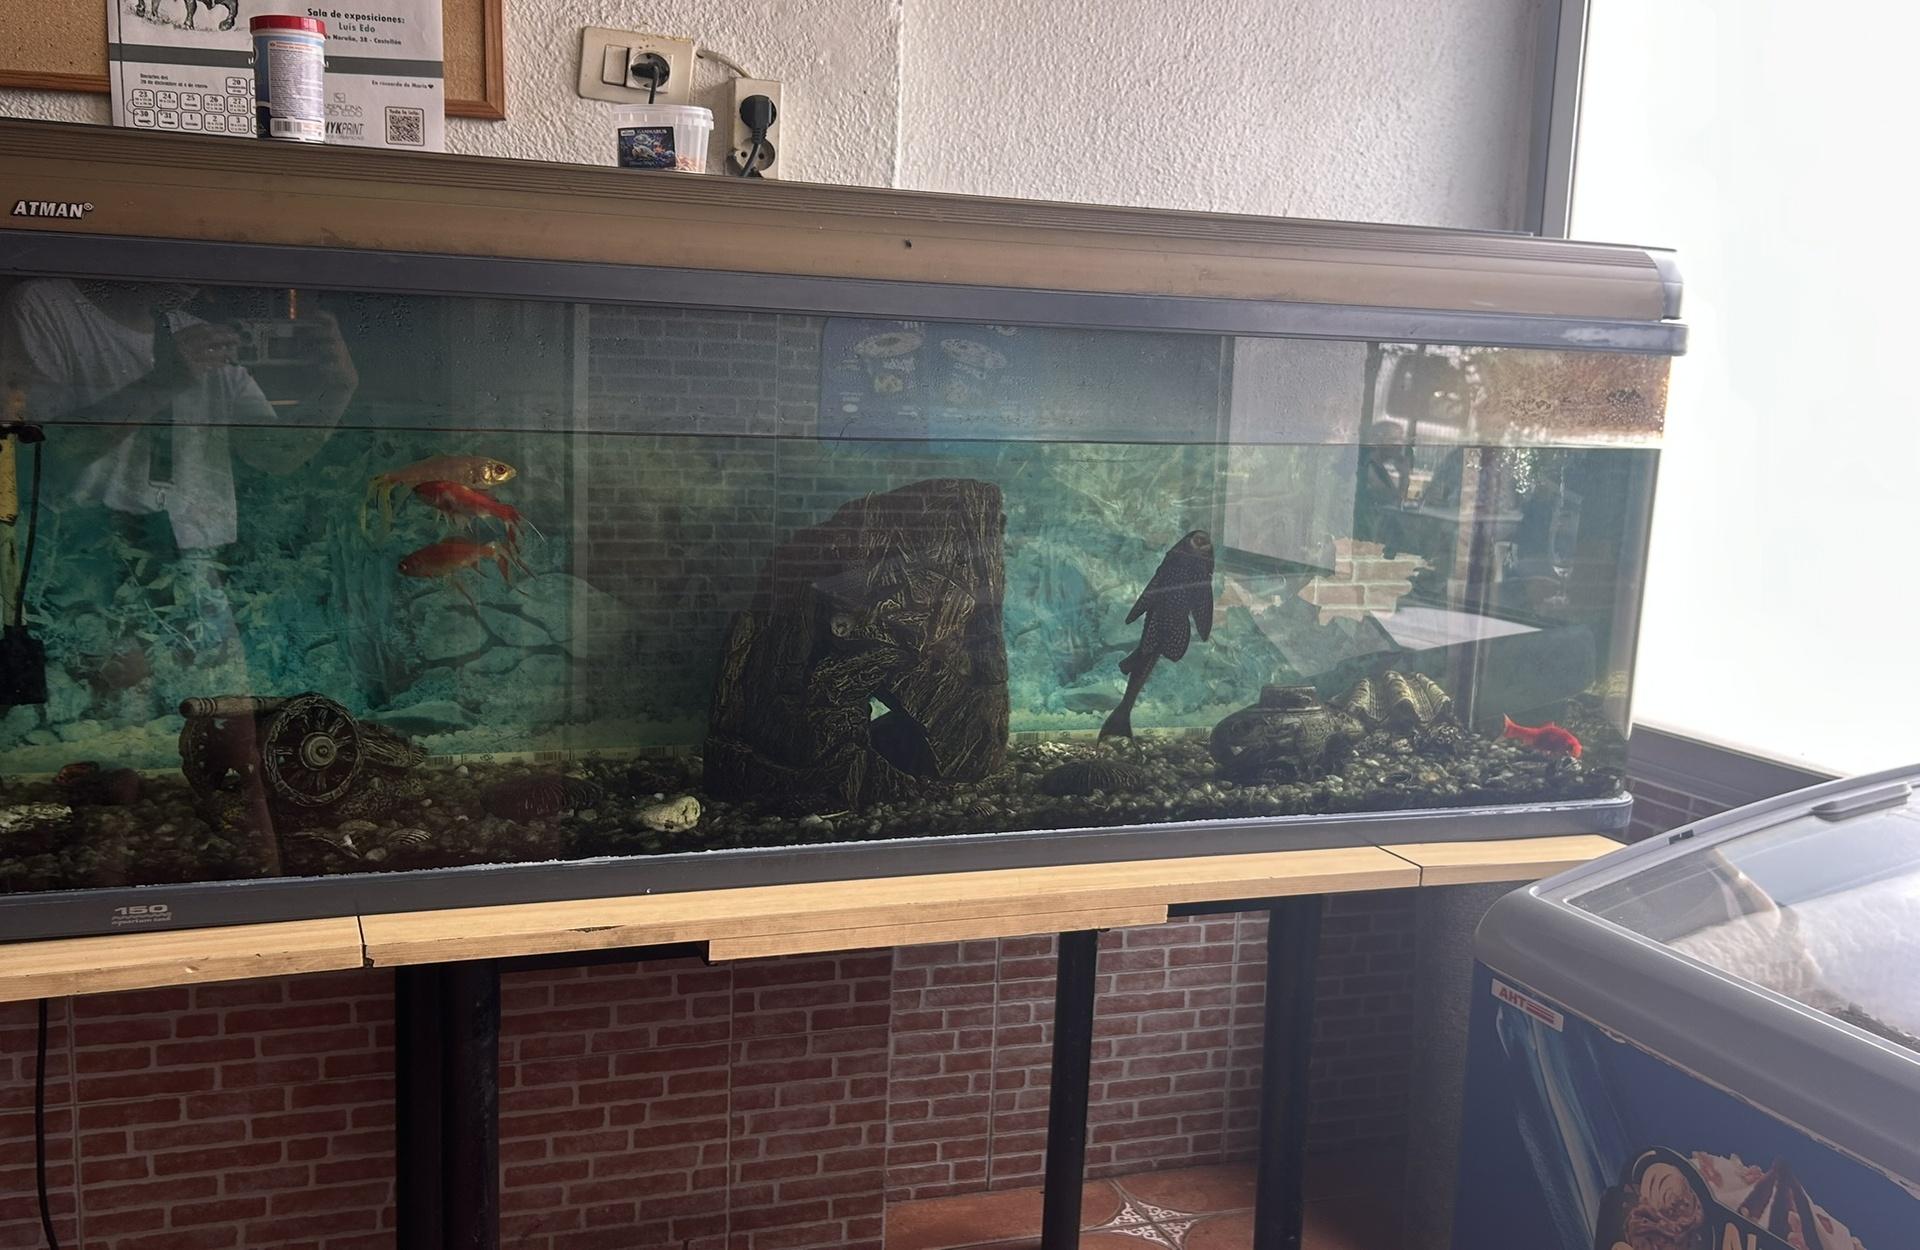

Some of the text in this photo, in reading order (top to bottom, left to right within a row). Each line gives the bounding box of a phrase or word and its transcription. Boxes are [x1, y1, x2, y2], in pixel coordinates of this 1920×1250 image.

[307, 8, 405, 24] Sala de exposiciones:
[339, 22, 376, 33] Luis Edo
[114, 904, 168, 915] 150
[1498, 987, 1527, 1008] AHT
